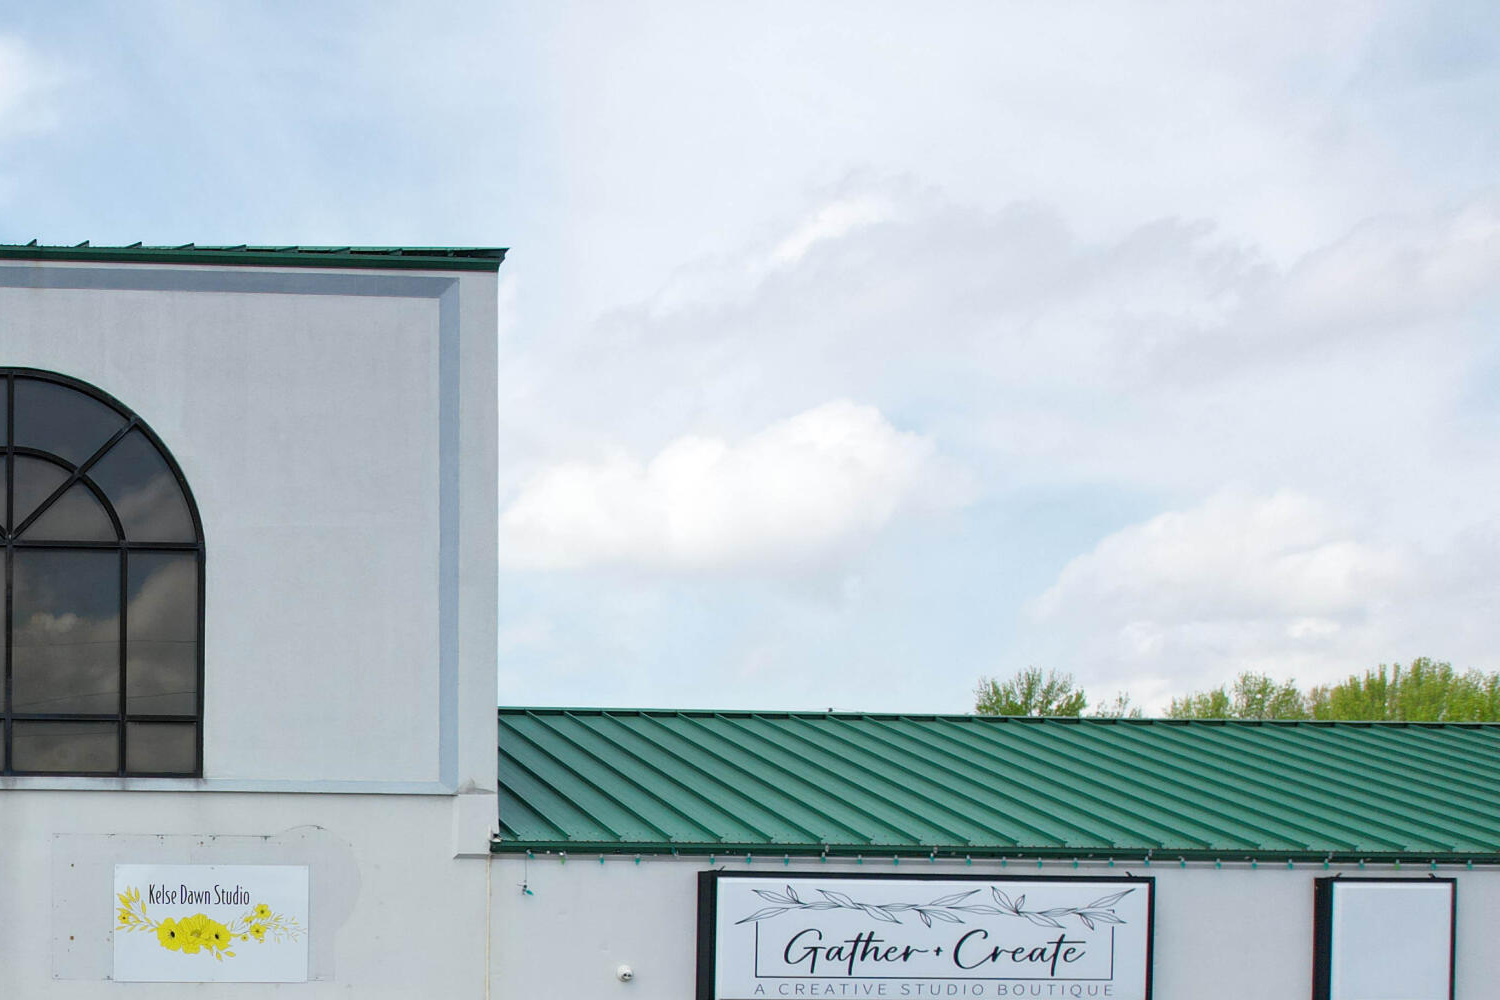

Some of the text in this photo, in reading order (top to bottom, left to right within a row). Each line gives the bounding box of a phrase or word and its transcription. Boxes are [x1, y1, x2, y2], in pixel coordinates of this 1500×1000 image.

[149, 883, 250, 906] Kelse Dawn Studio
[783, 928, 930, 975] Gather
[953, 929, 1086, 976] Create
[754, 983, 1115, 999] A CREATIVE STUDIO BOUTIQUE
